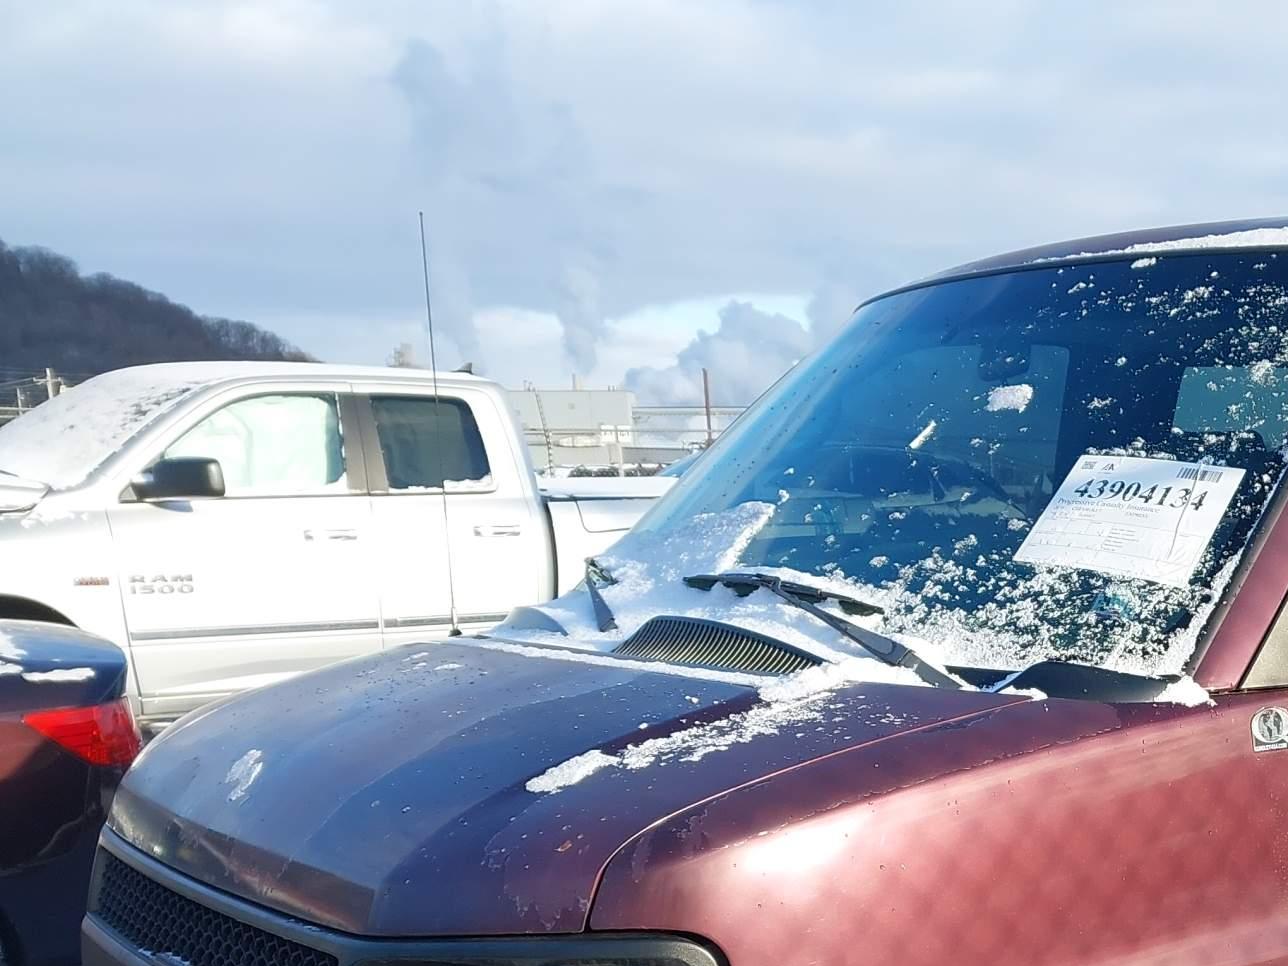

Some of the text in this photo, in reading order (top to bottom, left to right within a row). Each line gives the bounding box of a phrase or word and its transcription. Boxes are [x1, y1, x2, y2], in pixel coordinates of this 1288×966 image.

[1074, 478, 1209, 512] 43904134
[128, 574, 193, 583] RAM
[130, 584, 194, 594] 1500
